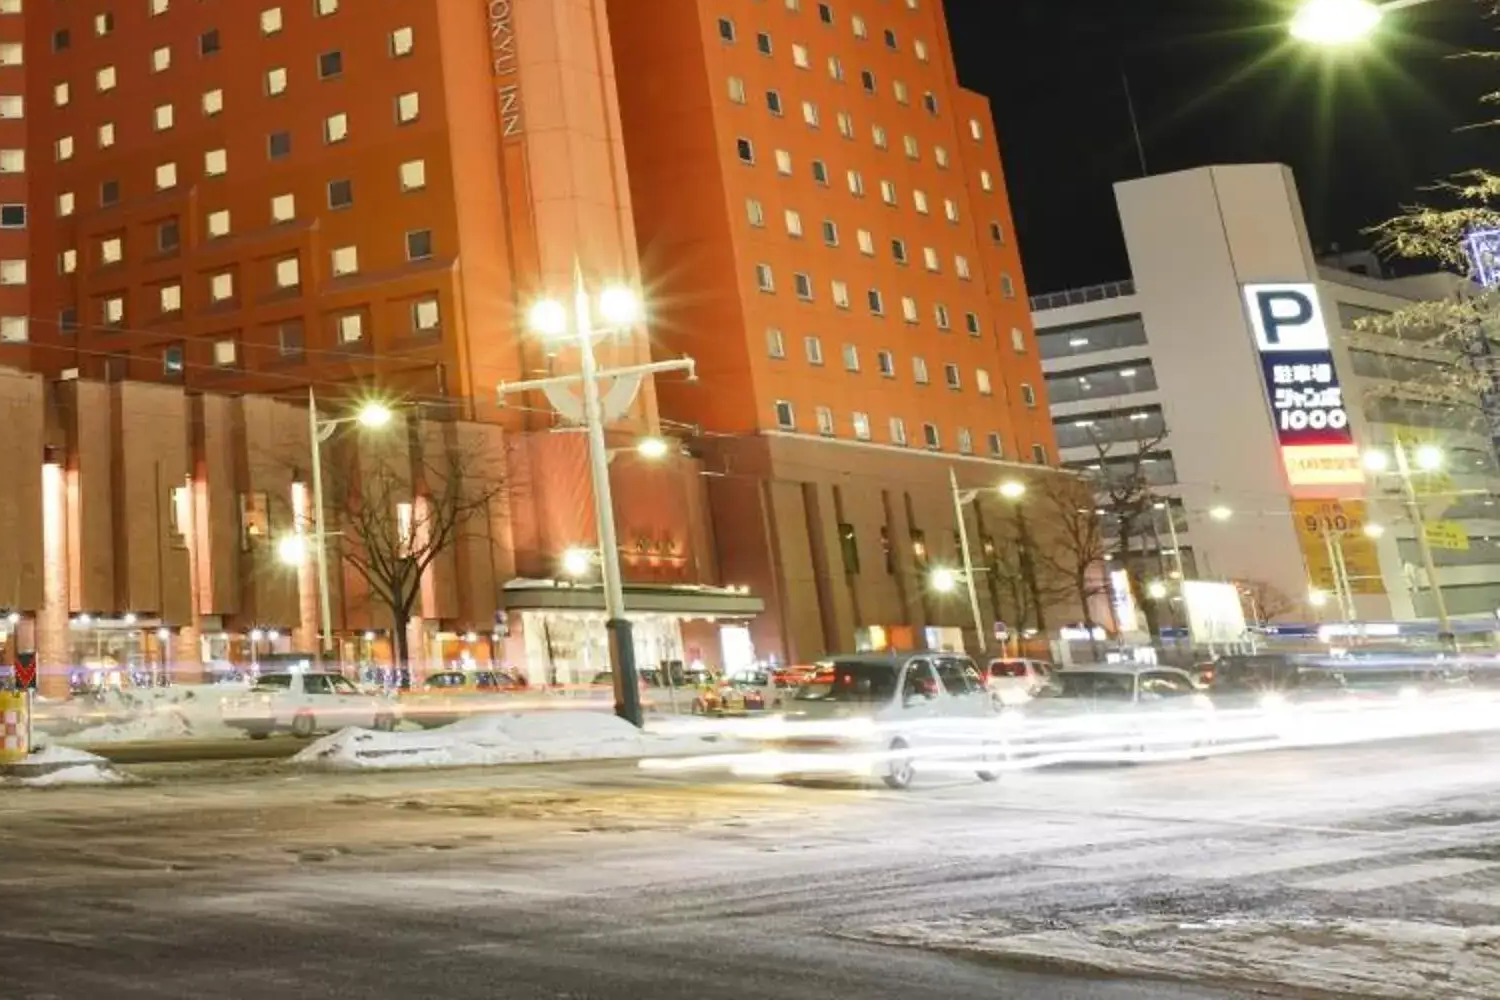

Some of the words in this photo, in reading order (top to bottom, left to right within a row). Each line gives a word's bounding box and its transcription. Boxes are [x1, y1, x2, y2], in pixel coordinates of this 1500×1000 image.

[499, 84, 524, 137] INN
[1256, 290, 1313, 344] P
[1273, 363, 1332, 384] 駐車場
[1280, 409, 1348, 430] 1000
